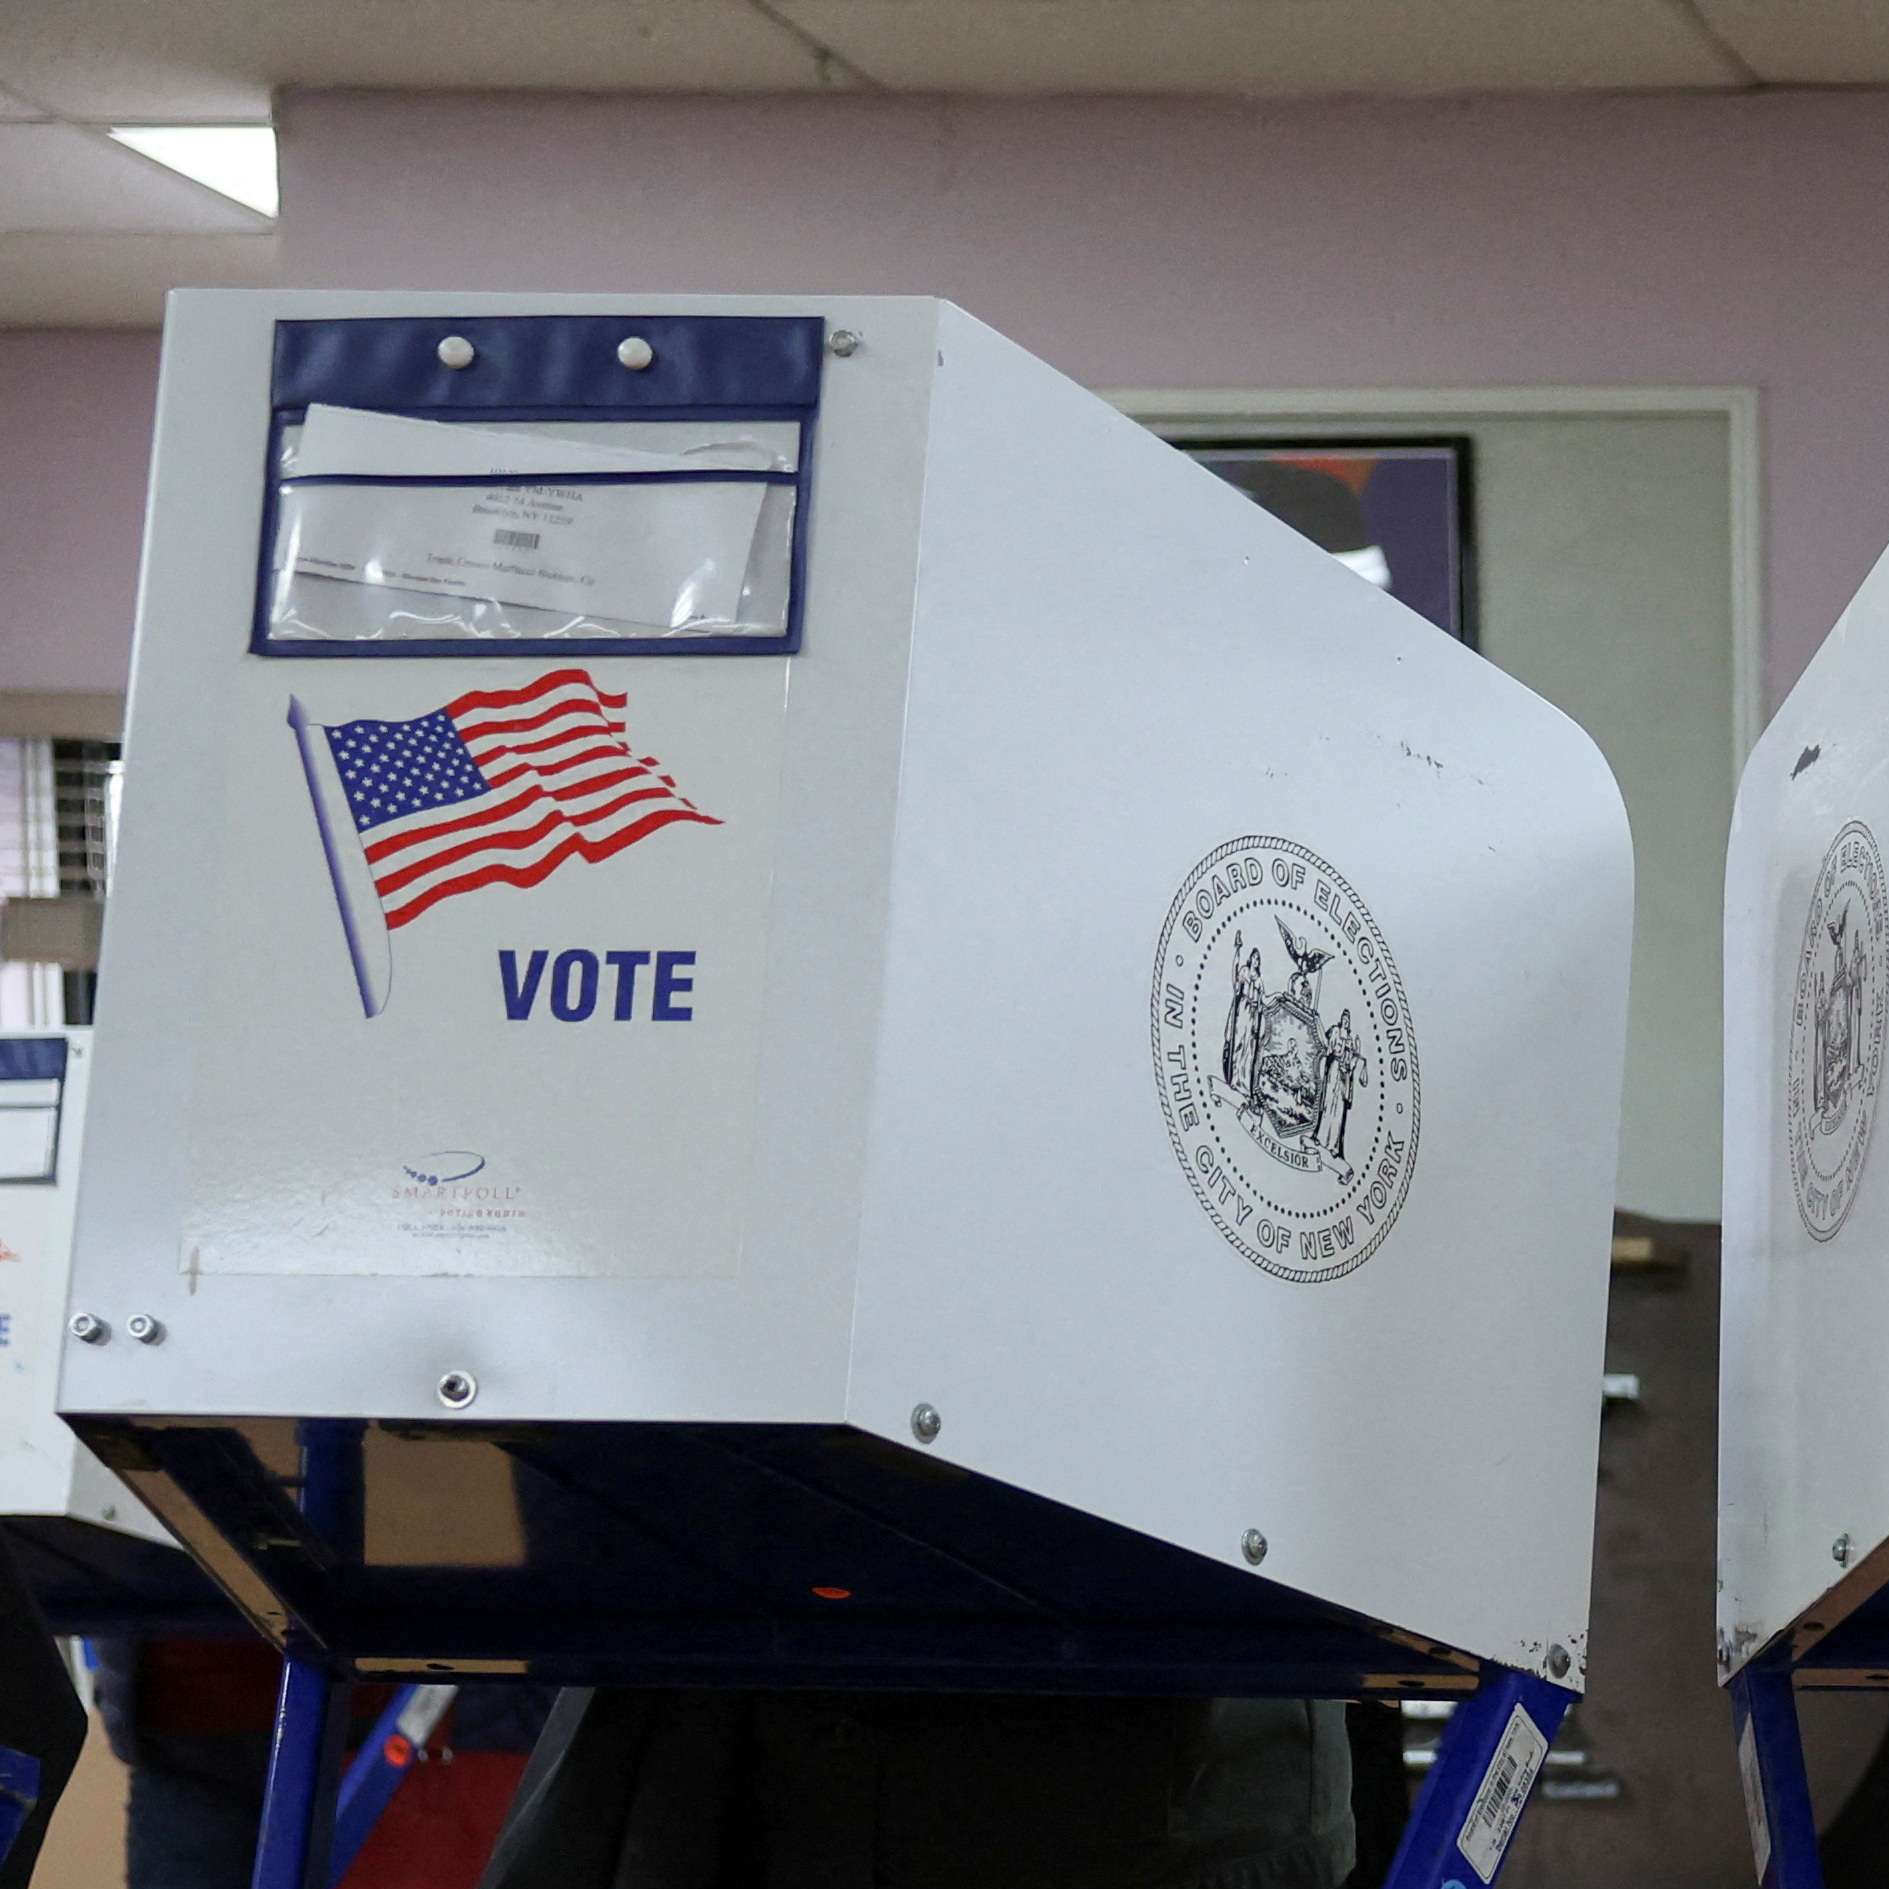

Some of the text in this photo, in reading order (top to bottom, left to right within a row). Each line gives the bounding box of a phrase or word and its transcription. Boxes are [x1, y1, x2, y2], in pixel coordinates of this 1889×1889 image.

[500, 950, 696, 1022] VOTE
[1182, 857, 1408, 1082] BOARD OF ELECTIONS
[1164, 983, 1404, 1260] IN THE CITY OF NEW YORK
[1249, 1121, 1310, 1169] EXCELSIOR
